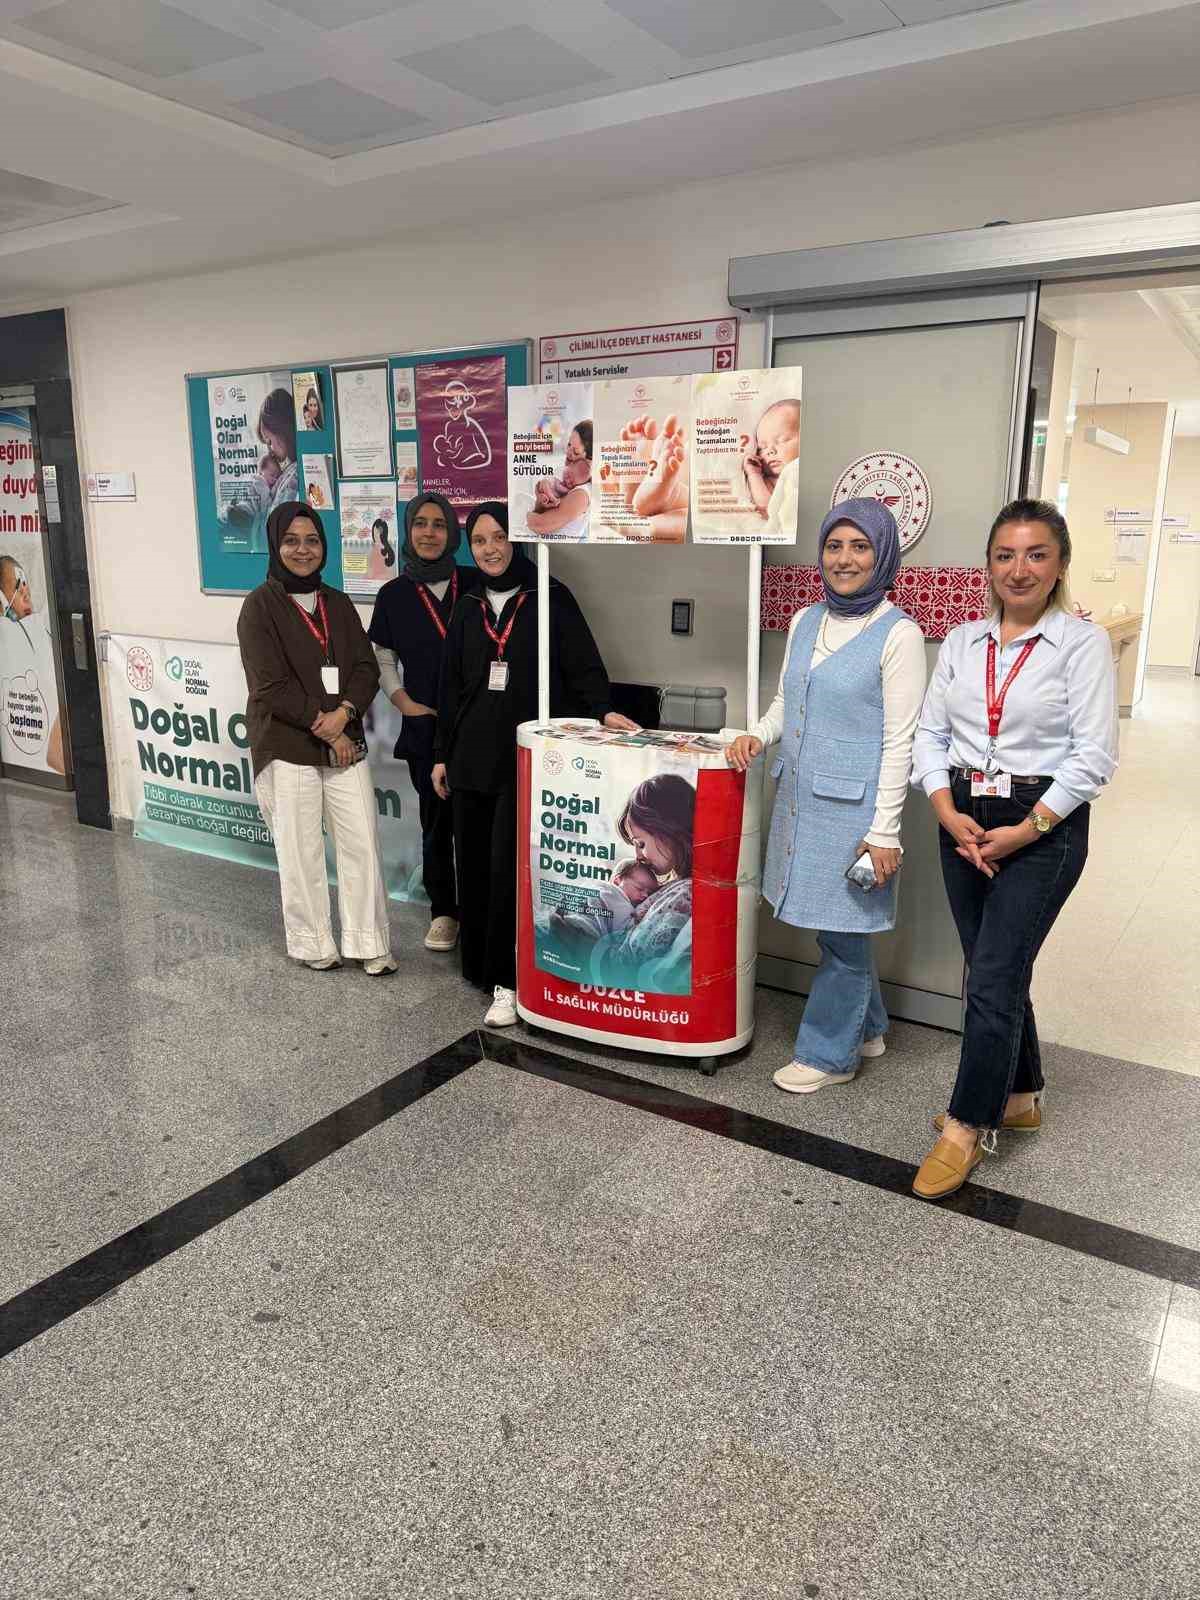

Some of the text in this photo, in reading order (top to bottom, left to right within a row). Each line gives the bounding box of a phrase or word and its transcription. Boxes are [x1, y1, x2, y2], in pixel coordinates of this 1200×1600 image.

[569, 328, 702, 352] ÇİLİMLİ İLÇE DEVLET HASTANESİ
[565, 367, 591, 379] Yataklı
[592, 364, 628, 376] Servisler
[215, 414, 247, 433] Doğal
[696, 417, 738, 426] Bebeğinizin
[217, 432, 242, 444] Olan
[513, 433, 552, 442] Bebeğiniz için
[696, 428, 730, 436] Yenidoğan
[524, 443, 532, 452] iyi
[740, 435, 750, 453] ?
[218, 445, 258, 460] Normal
[513, 455, 537, 464] ANNE
[219, 461, 257, 477] Doğum
[513, 465, 554, 476] SÜTÜDÜR
[185, 677, 209, 688] NORMAL
[185, 685, 207, 696] DOĞUM
[10, 713, 43, 728] başlama
[129, 697, 219, 747] Doğal
[137, 740, 252, 794] Normal
[170, 791, 204, 809] olarak
[207, 800, 253, 819] zorunlu
[542, 789, 600, 816] Doğal
[147, 805, 194, 825] sezaryen
[197, 816, 228, 834] doğal
[541, 811, 588, 835] Olan
[540, 832, 616, 860] Normal
[539, 853, 613, 882] Doğum
[543, 987, 689, 1025] İL SAĞLIK MÜDÜRLÜĞÜ
